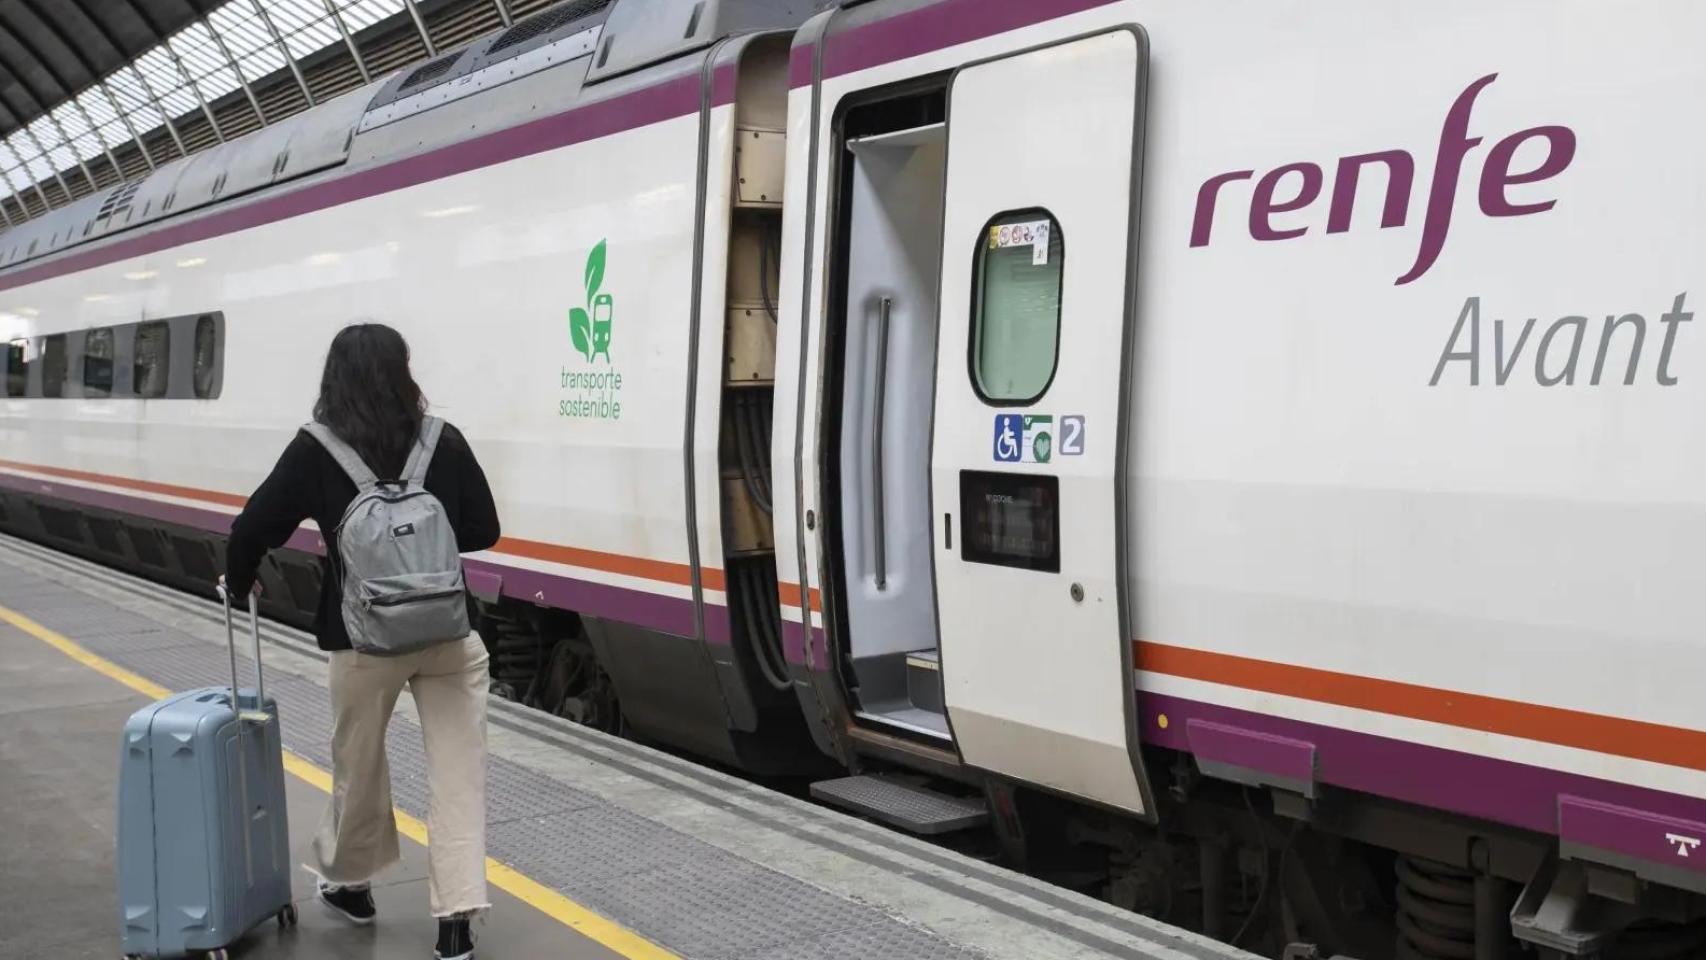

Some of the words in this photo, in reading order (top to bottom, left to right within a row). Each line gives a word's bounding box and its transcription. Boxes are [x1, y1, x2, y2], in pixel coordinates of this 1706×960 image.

[1189, 73, 1577, 286] renfe
[1428, 291, 1694, 387] Avant
[561, 365, 622, 396] transporte
[560, 391, 621, 420] sostenible
[1062, 418, 1081, 453] 2
